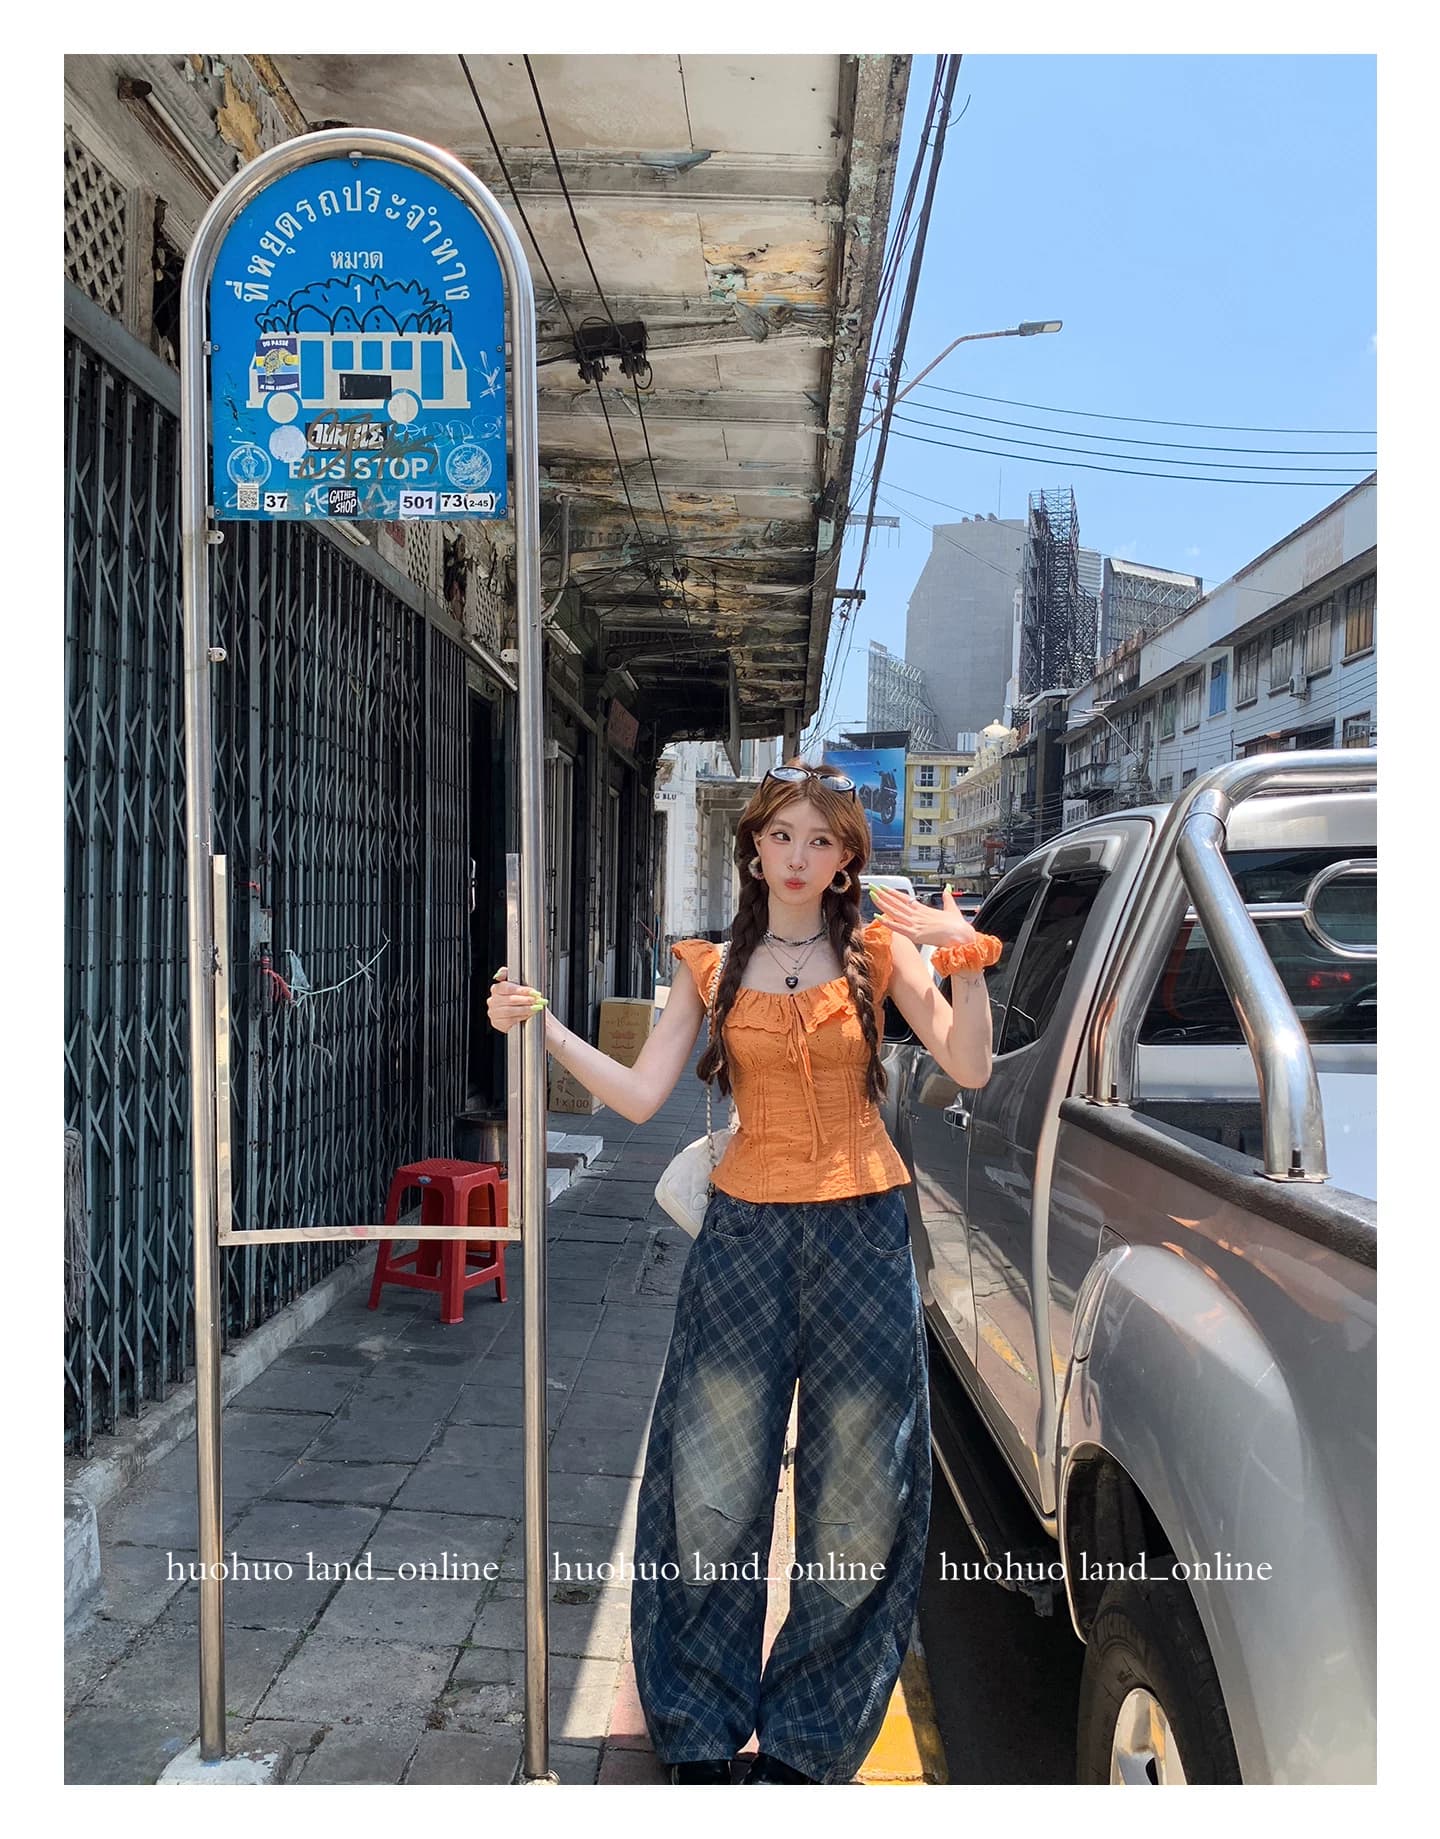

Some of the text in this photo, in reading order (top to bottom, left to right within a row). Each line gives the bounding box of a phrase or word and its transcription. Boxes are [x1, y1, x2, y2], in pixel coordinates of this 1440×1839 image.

[330, 250, 383, 270] หมวด
[353, 284, 361, 303] 1
[288, 458, 429, 479] BUS STOP
[266, 494, 288, 508] 37
[329, 489, 357, 504] GATHER
[402, 496, 434, 509] 501
[333, 498, 357, 513] SHOP
